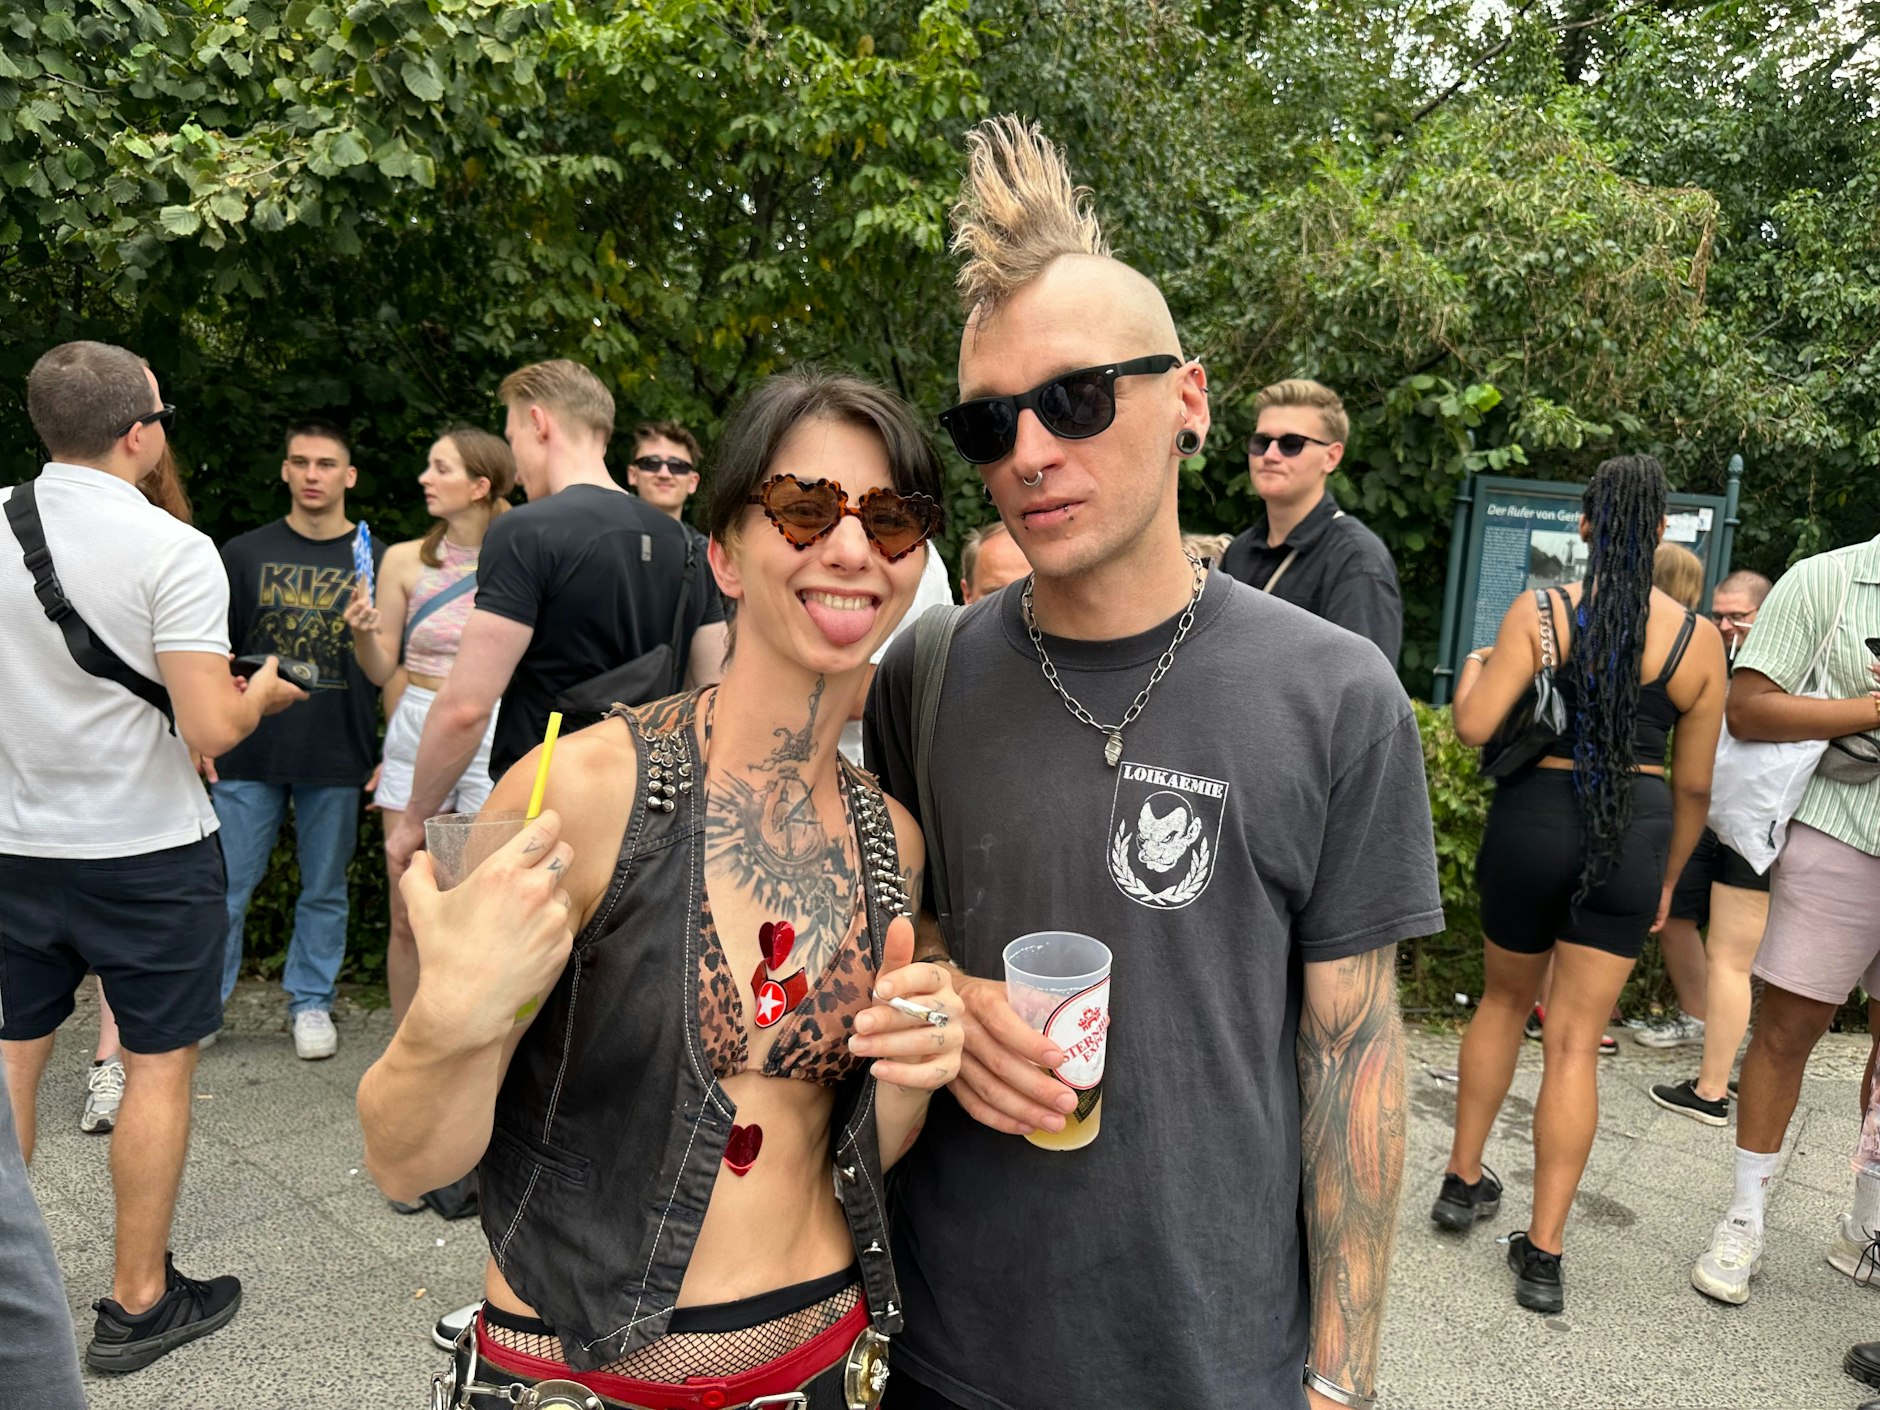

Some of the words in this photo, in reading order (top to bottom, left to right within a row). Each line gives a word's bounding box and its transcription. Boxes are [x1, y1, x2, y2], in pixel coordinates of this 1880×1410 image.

[1487, 503, 1507, 516] Der
[1507, 505, 1535, 518] Rufer
[1536, 509, 1555, 520] von
[1123, 765, 1225, 799] LOIKAEMIE
